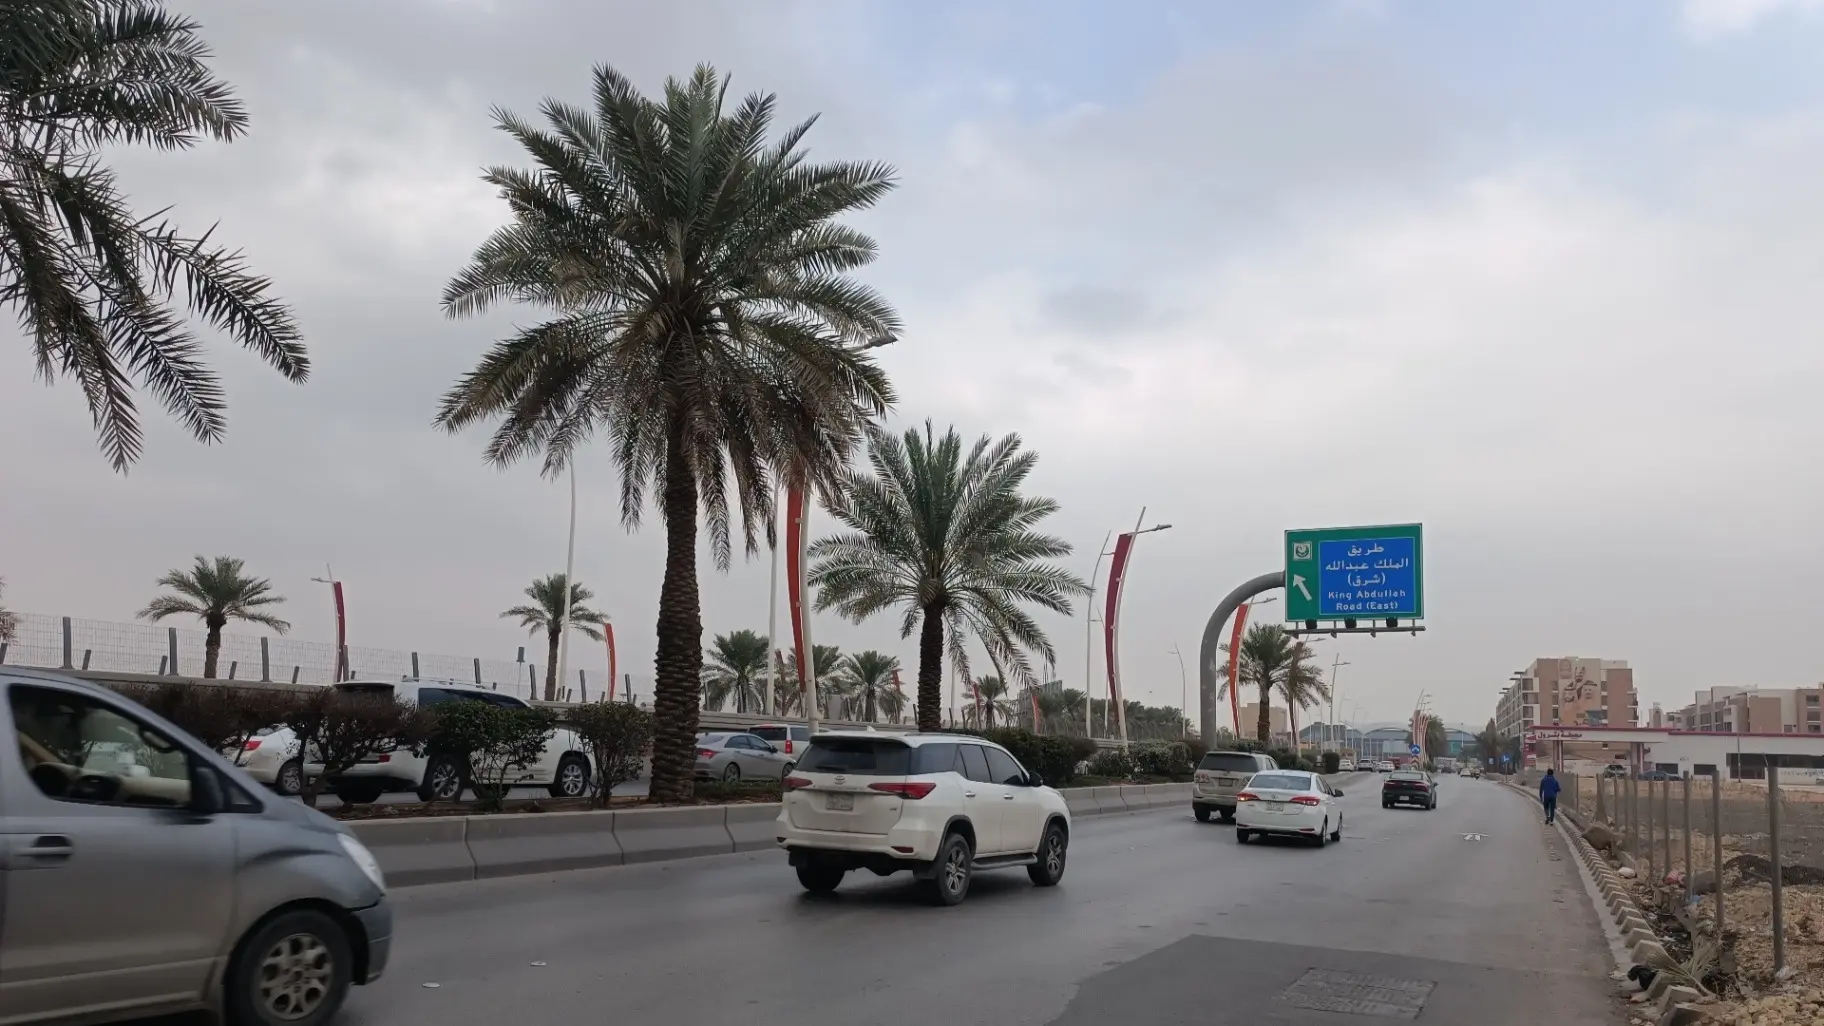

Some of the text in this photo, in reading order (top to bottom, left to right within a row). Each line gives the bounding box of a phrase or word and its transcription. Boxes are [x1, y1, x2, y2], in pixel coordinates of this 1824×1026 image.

[1347, 543, 1384, 556] طريق
[1325, 558, 1408, 571] الملك عبدالله
[1347, 572, 1385, 586] (شرق)
[1328, 589, 1406, 601] King Abdullah
[1336, 601, 1398, 611] Road (East)
